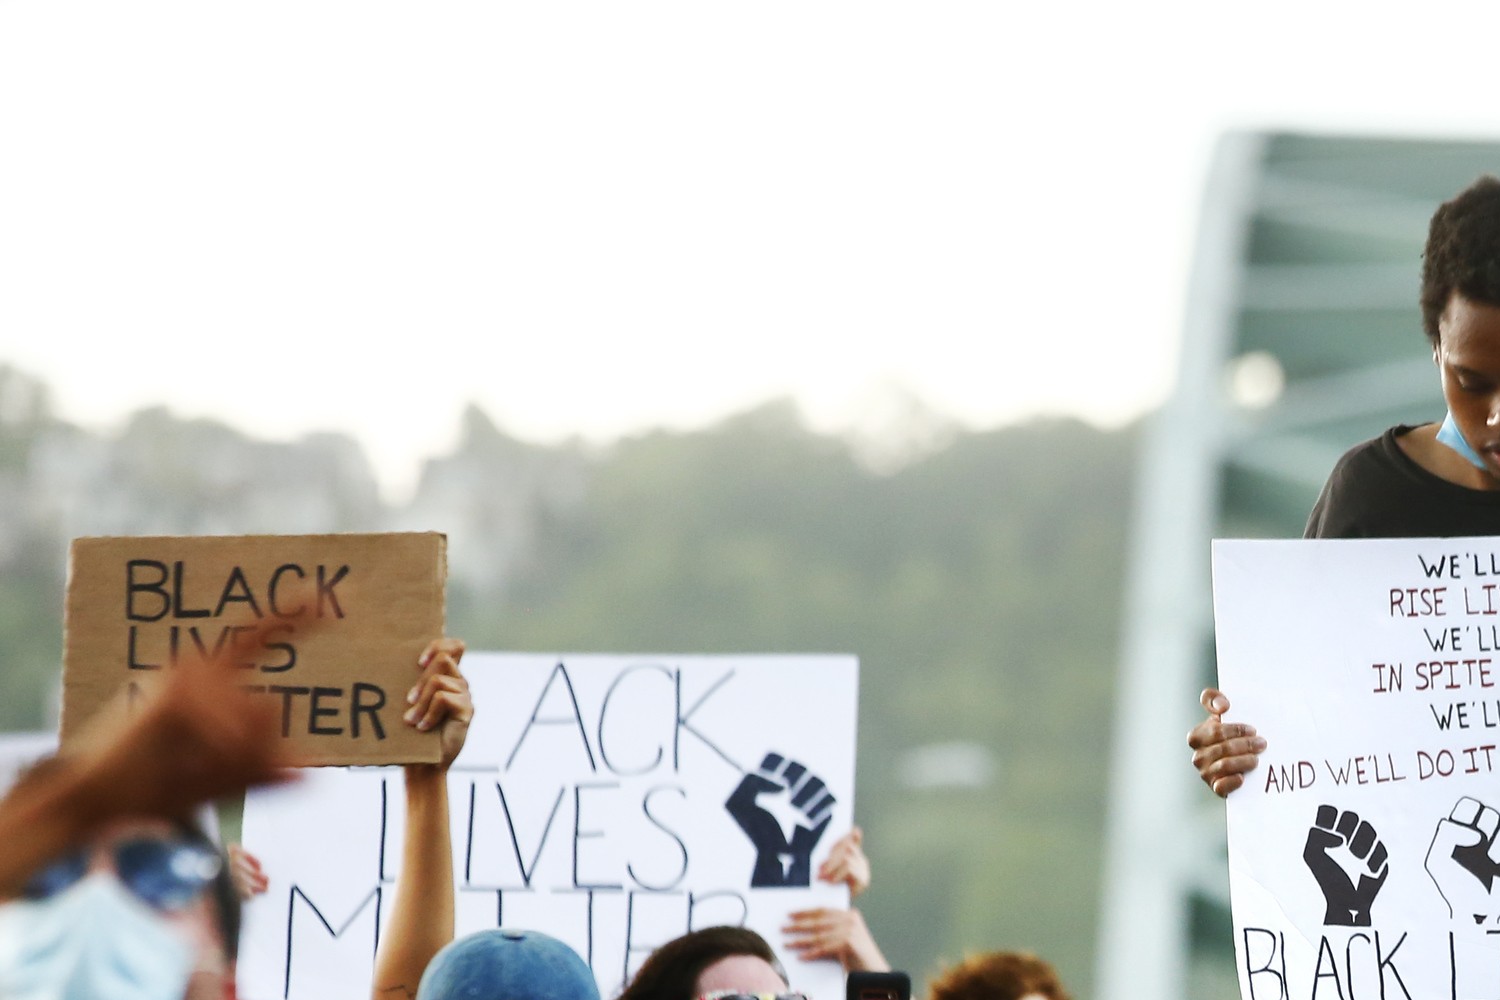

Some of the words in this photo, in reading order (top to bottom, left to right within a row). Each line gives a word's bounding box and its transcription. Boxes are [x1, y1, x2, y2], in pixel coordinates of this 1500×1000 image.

[125, 559, 350, 623] BLACK
[1389, 587, 1448, 617] RISE
[1371, 663, 1403, 693] IN
[1414, 658, 1495, 691] SPITE
[1264, 760, 1316, 794] AND
[1325, 753, 1407, 786] WE'LL
[1416, 749, 1455, 781] DO
[1462, 744, 1496, 775] IT
[379, 778, 689, 893] LIVES
